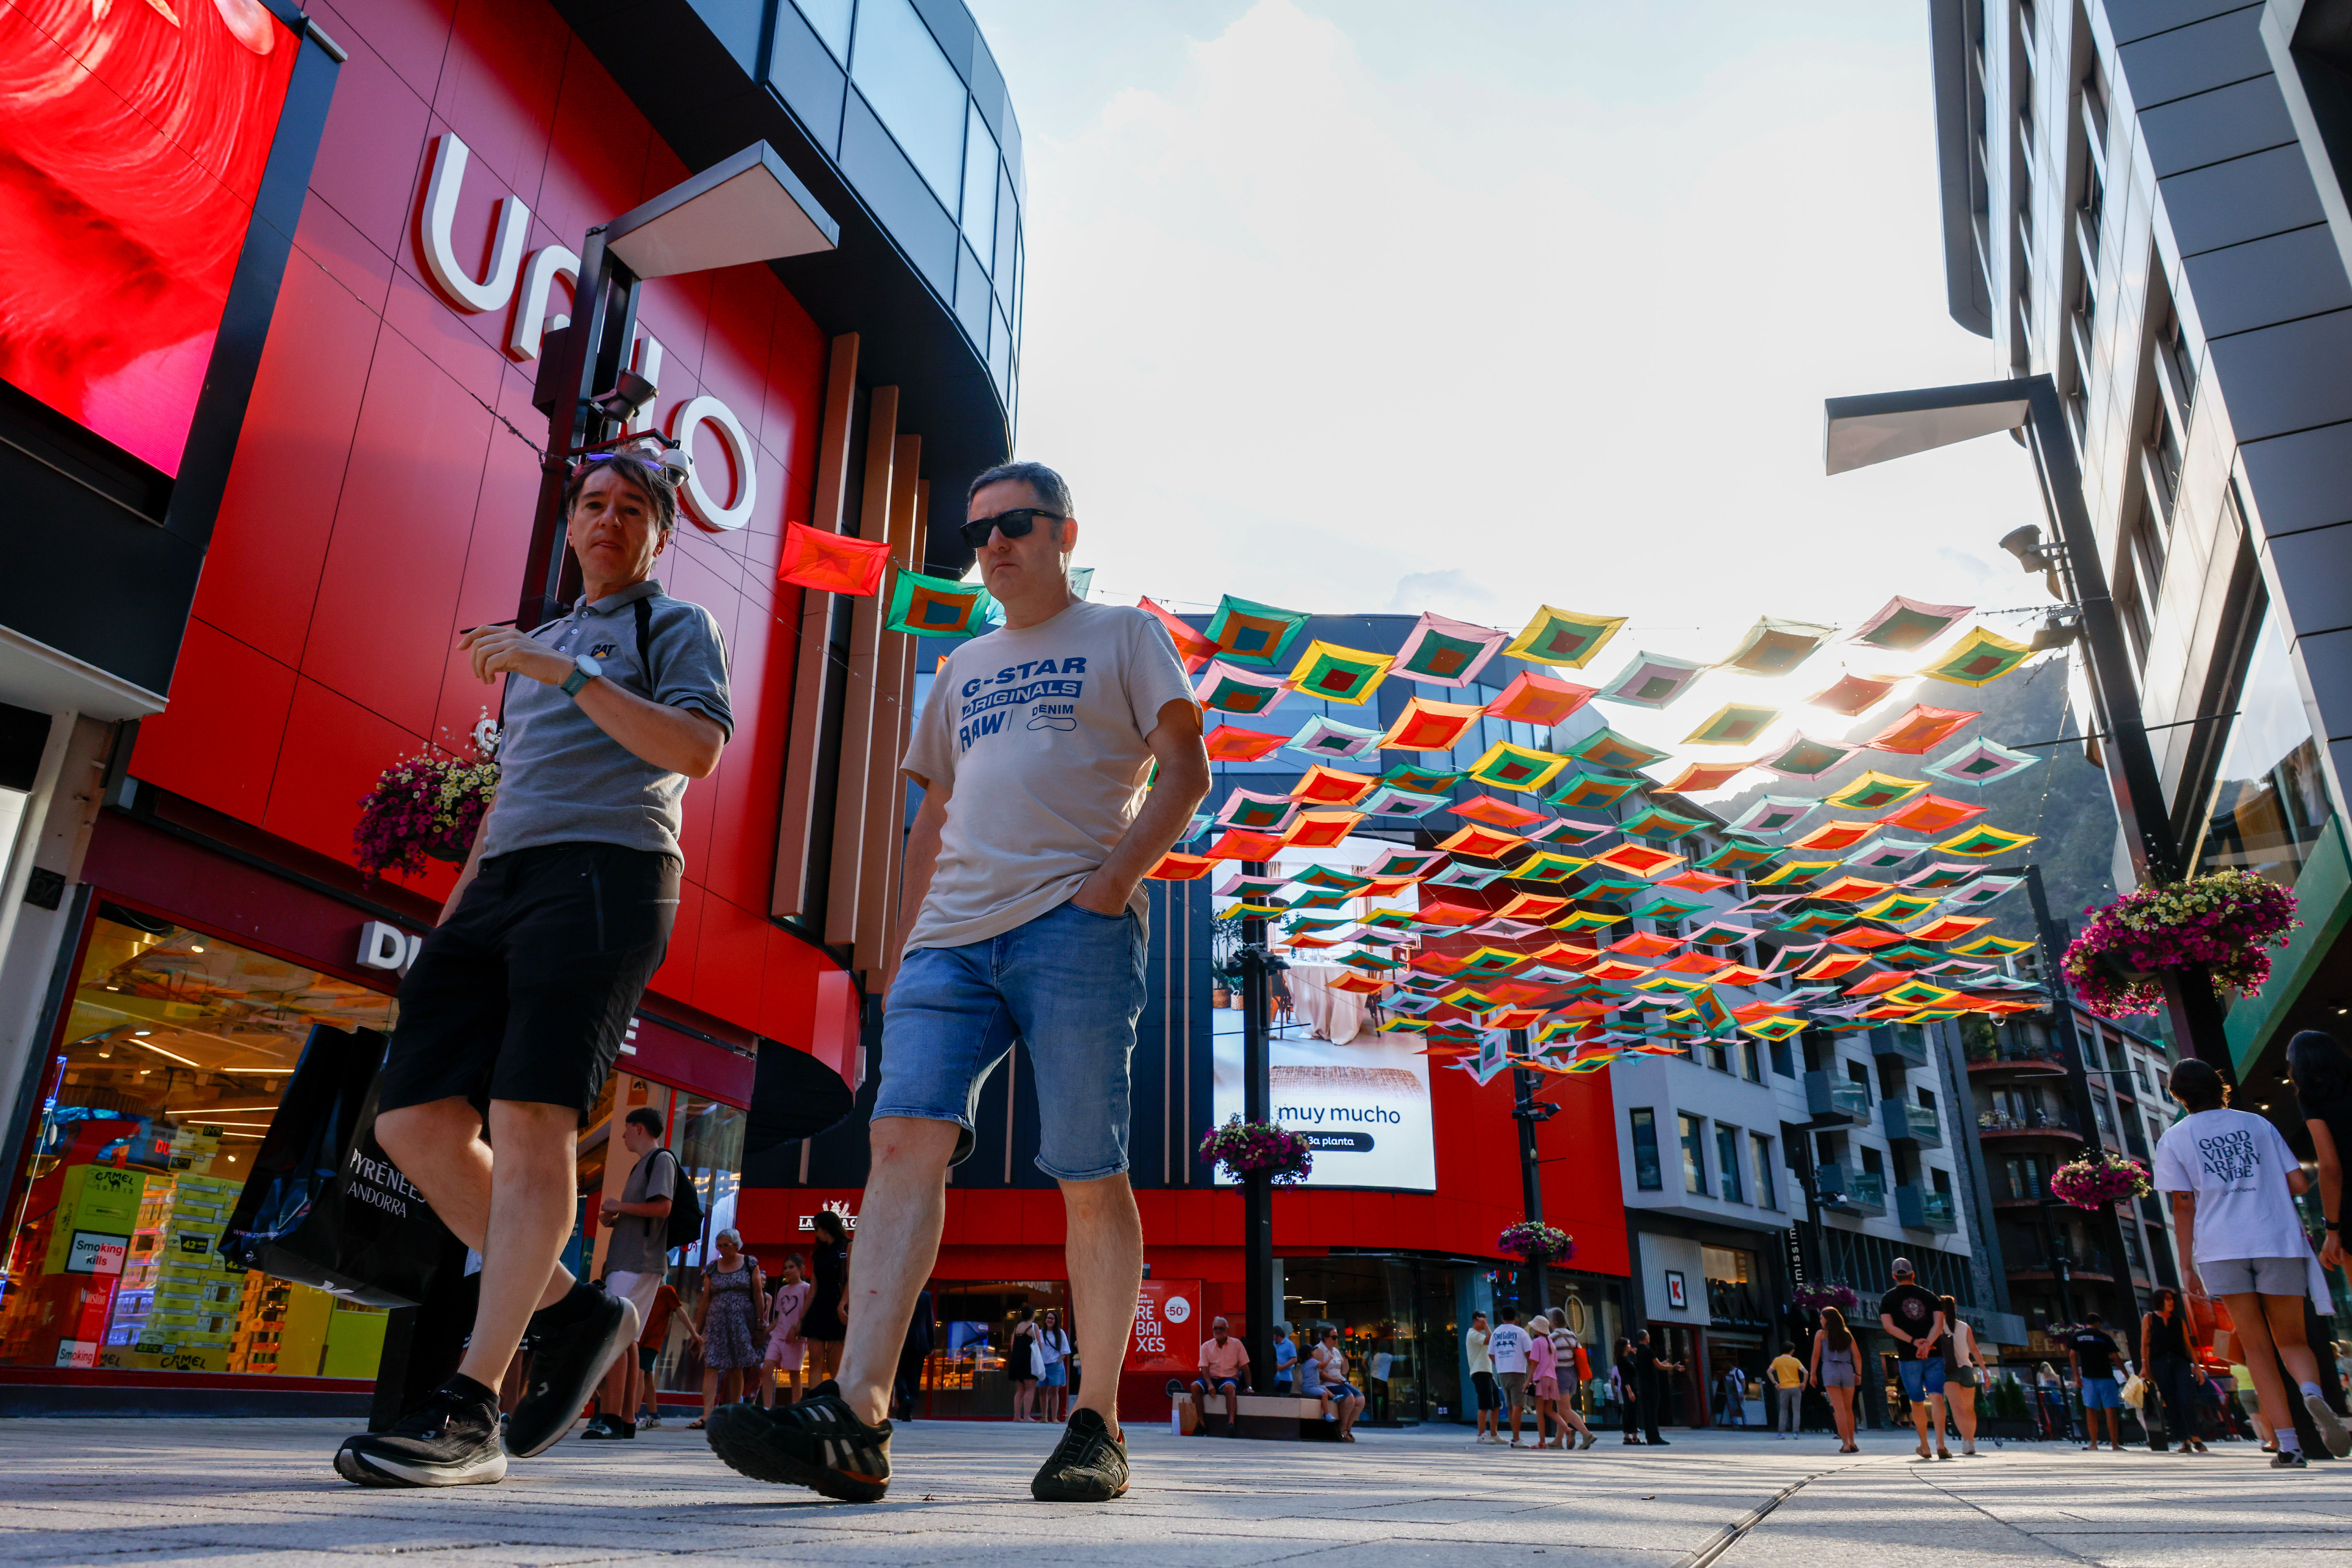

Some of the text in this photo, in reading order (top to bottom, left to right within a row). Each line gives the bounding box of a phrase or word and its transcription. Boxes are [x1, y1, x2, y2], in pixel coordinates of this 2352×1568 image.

[590, 644, 616, 657] CAT
[962, 657, 1087, 697] G-STAR
[964, 682, 1078, 717] ORIGINALS
[1032, 705, 1074, 716] DENIM
[959, 710, 1006, 753] RAW
[1278, 1105, 1401, 1123] muy mucho
[1308, 1136, 1354, 1147] 3a planta
[2199, 1130, 2250, 1150] GOOD
[2201, 1141, 2253, 1161] VIBES
[2204, 1153, 2260, 1173] ARE MY
[95, 1171, 133, 1185] CAMEL
[2217, 1165, 2254, 1183] VIBE
[347, 1181, 406, 1218] ANDORRA
[799, 1218, 813, 1227] LA
[76, 1240, 123, 1256] Smoking
[86, 1254, 107, 1265] kills
[80, 1287, 106, 1305] Winston
[1672, 1281, 1681, 1299] K
[1136, 1305, 1154, 1320] RE
[1136, 1321, 1161, 1336] BAI
[1136, 1337, 1166, 1352] XES
[60, 1348, 93, 1368] Smoking
[160, 1354, 206, 1369] CAMEL
